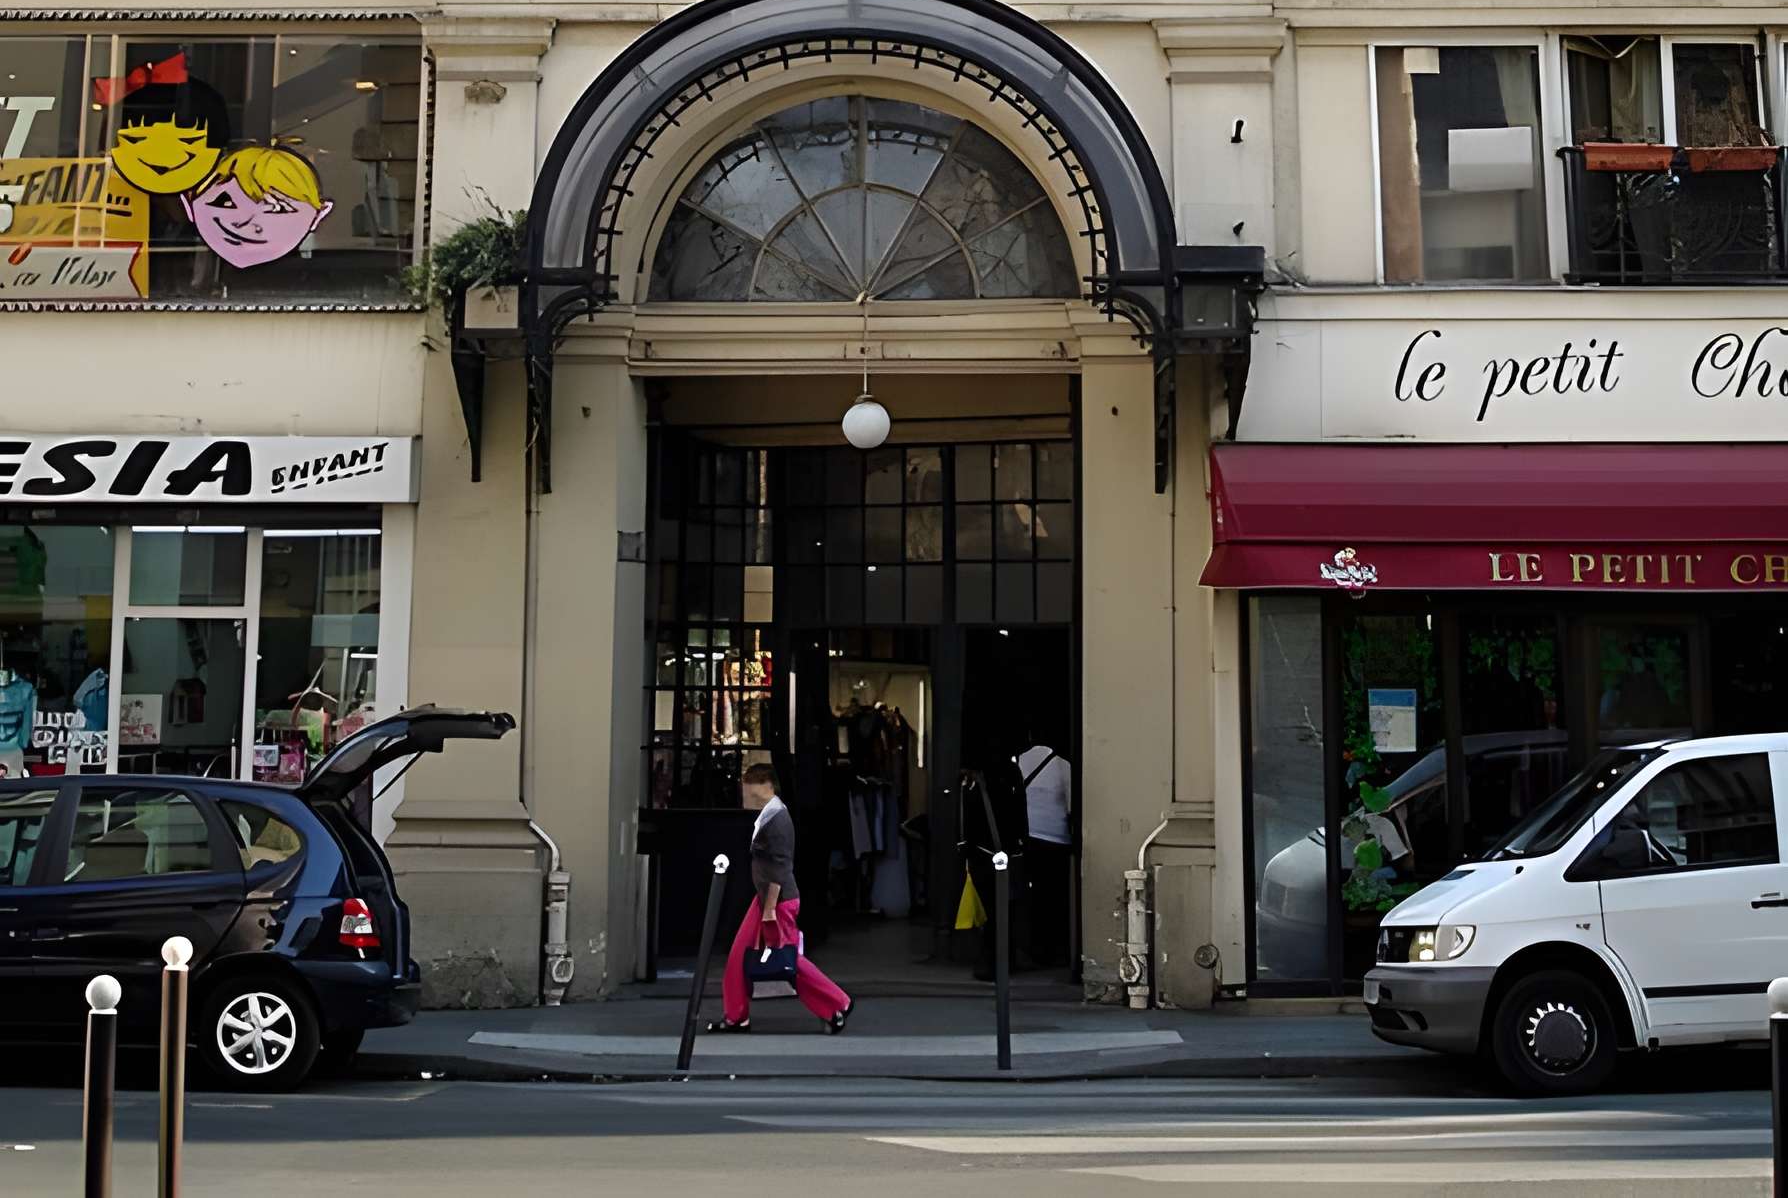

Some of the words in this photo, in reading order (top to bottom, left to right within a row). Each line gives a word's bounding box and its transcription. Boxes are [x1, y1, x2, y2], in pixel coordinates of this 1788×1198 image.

[1395, 330, 1446, 402] le
[1477, 338, 1624, 421] petit
[1489, 552, 1543, 582] LE
[1570, 553, 1702, 584] PETIT
